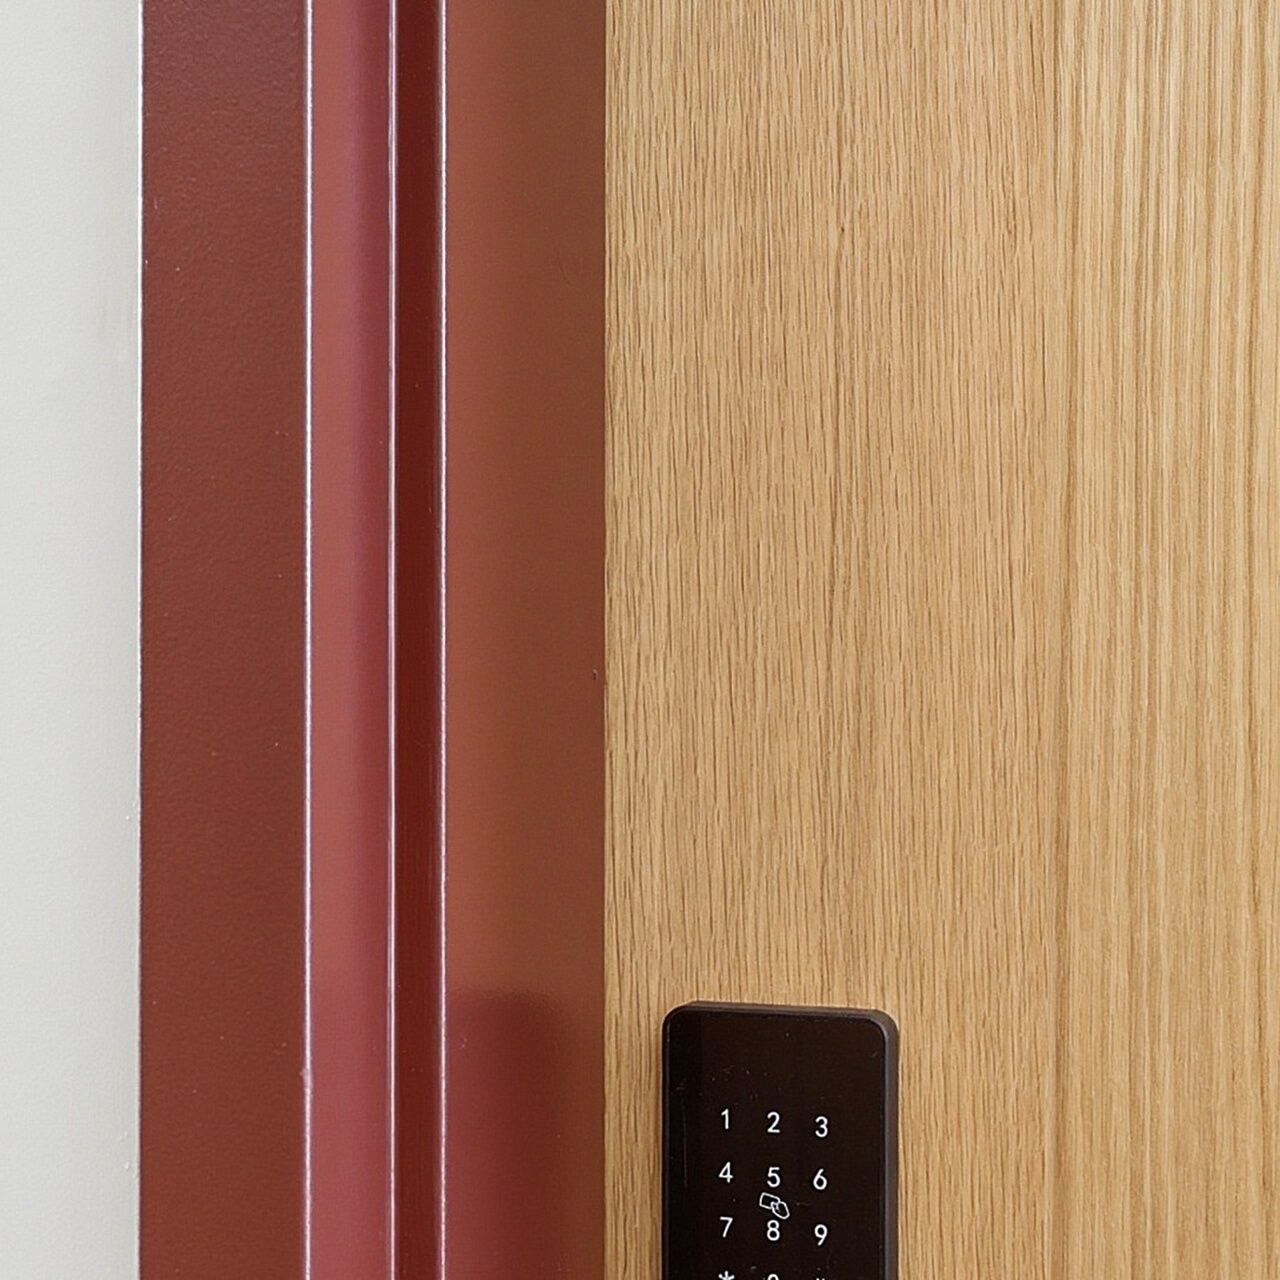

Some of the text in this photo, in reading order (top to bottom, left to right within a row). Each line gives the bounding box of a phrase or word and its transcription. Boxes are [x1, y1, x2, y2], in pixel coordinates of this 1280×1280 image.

[720, 1108, 829, 1138] 1 2 3
[718, 1161, 828, 1191] 4 5 6
[719, 1216, 828, 1246] 7 8 9
